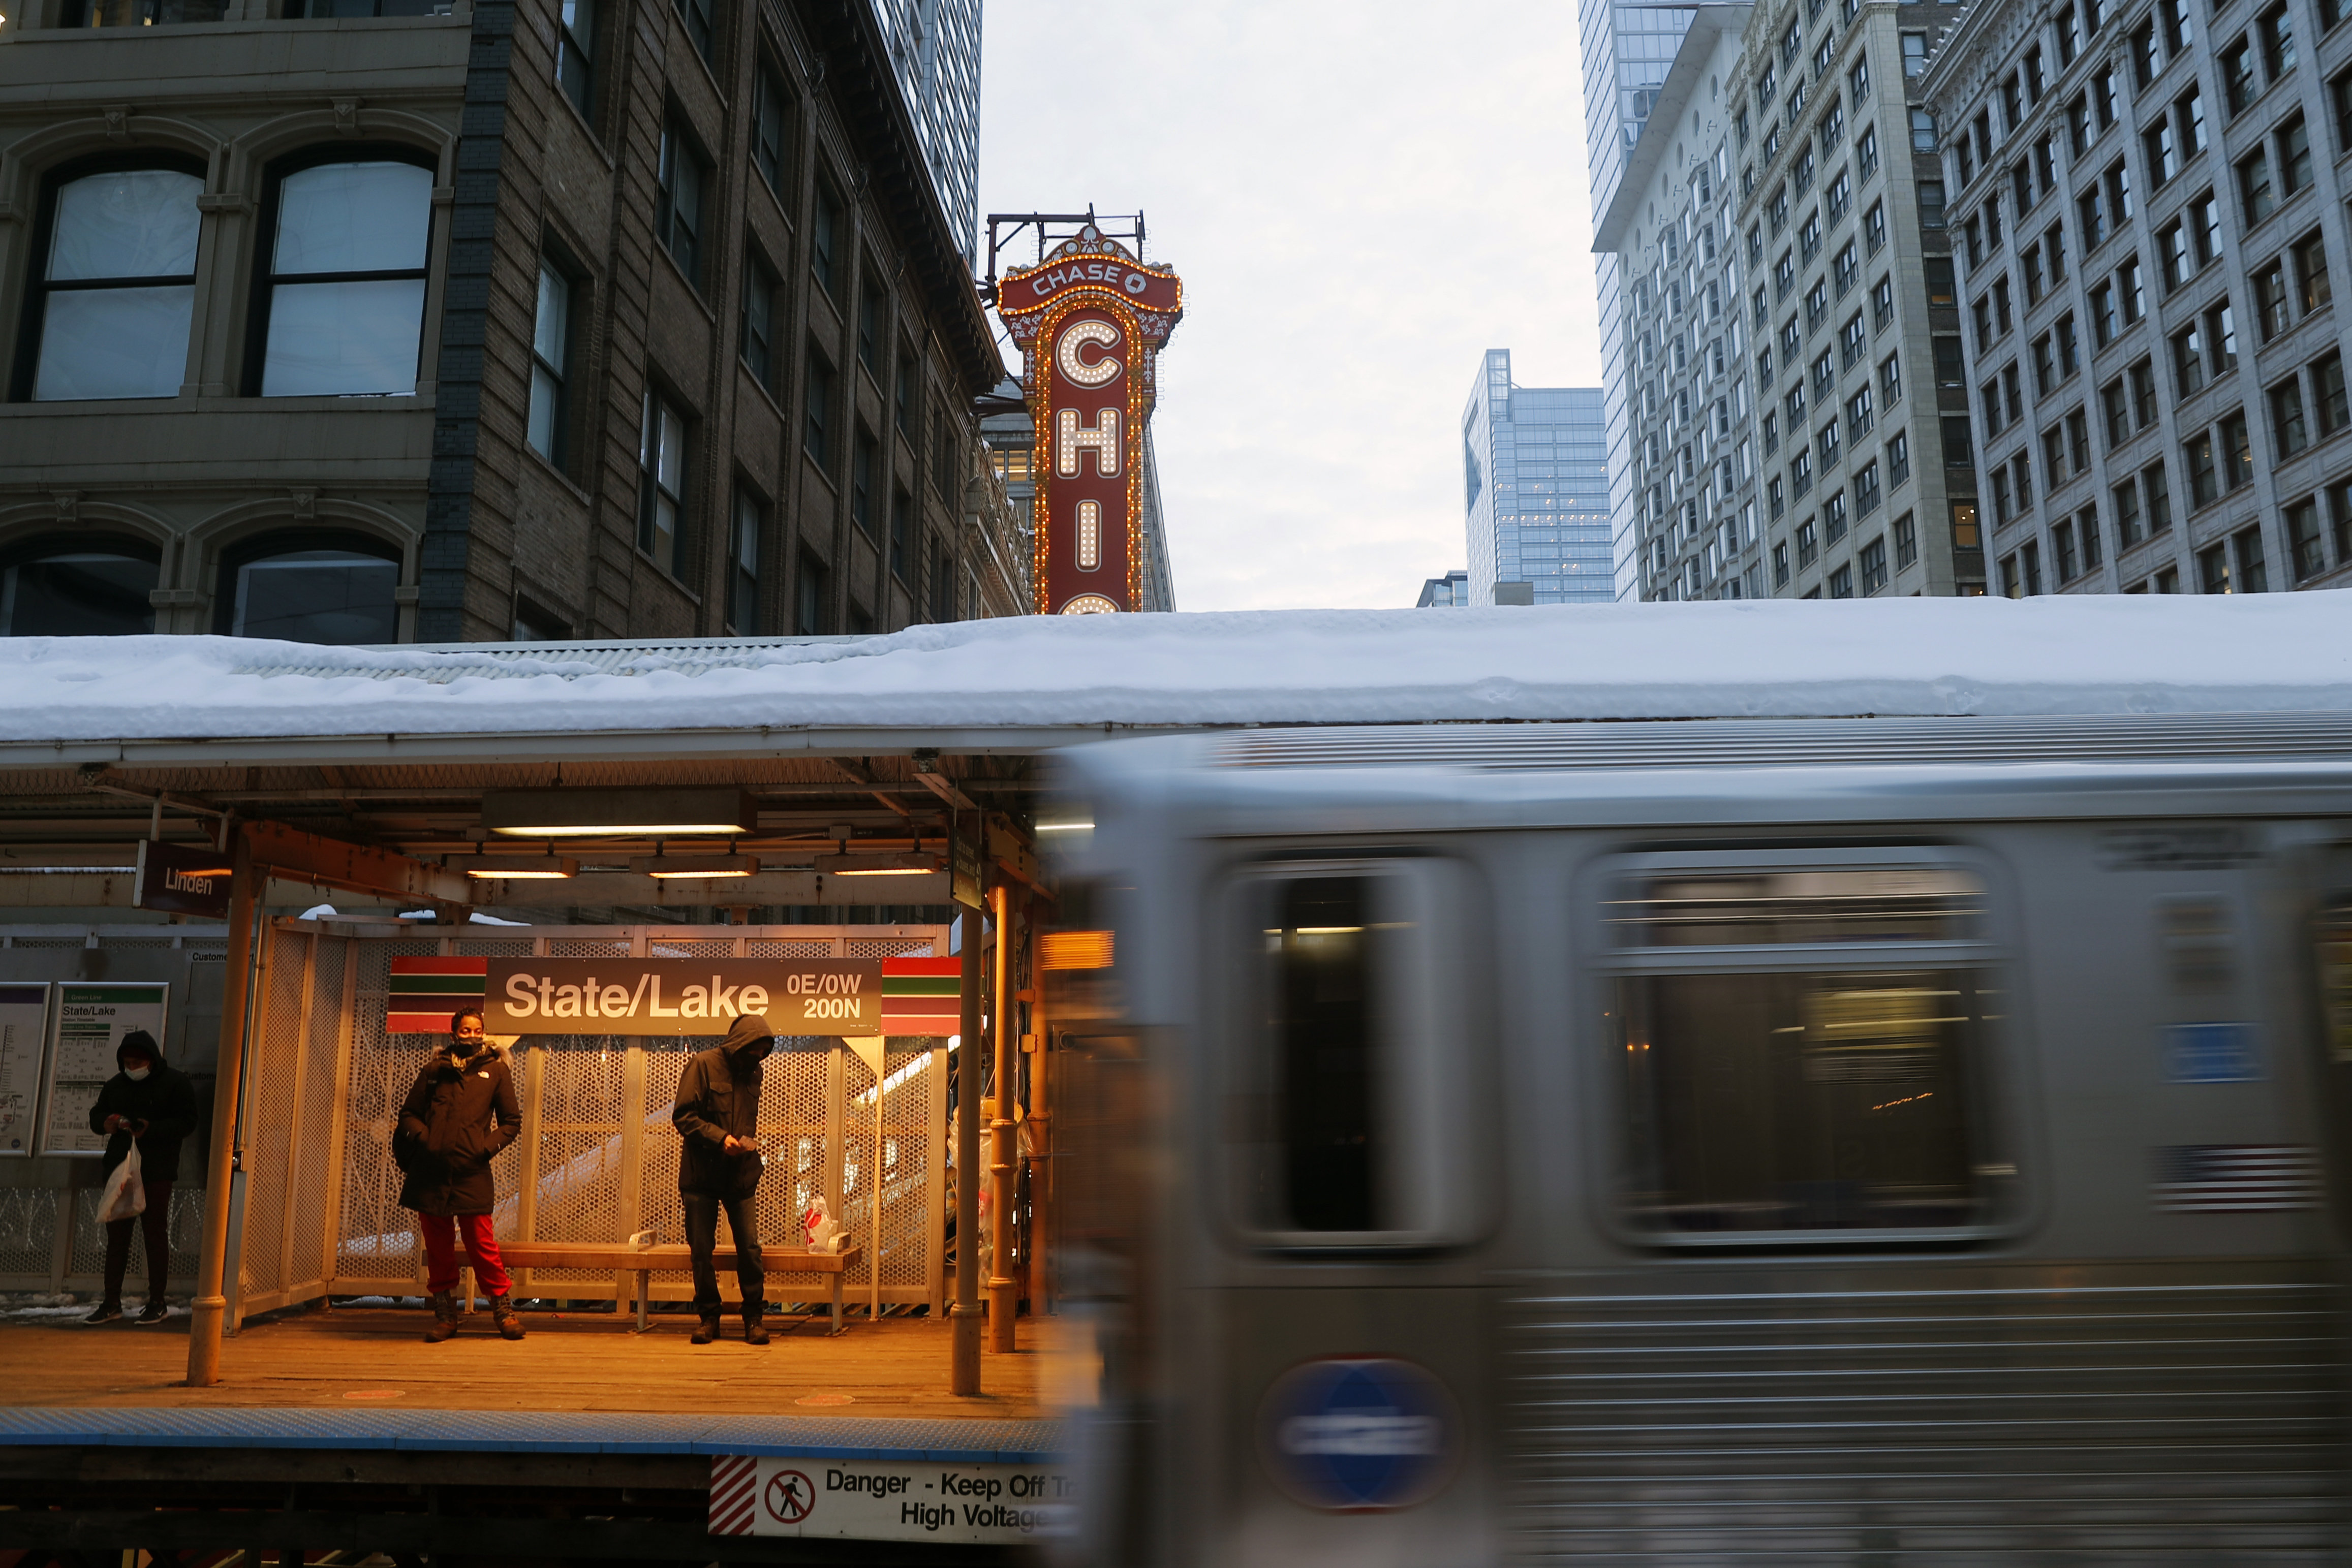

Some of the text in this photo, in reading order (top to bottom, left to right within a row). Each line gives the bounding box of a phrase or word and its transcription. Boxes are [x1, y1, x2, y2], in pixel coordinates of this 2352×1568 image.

[1032, 264, 1121, 295] CHASE
[1056, 319, 1123, 614] CHI
[165, 867, 212, 895] Linden
[63, 1006, 116, 1016] State/Lake
[504, 973, 769, 1018] State/Lake
[803, 998, 861, 1019] 200N
[826, 1469, 911, 1498] Danger
[941, 1473, 1002, 1502] Keep
[1009, 1475, 1045, 1497] Off
[902, 1502, 1049, 1533] High Voltage
